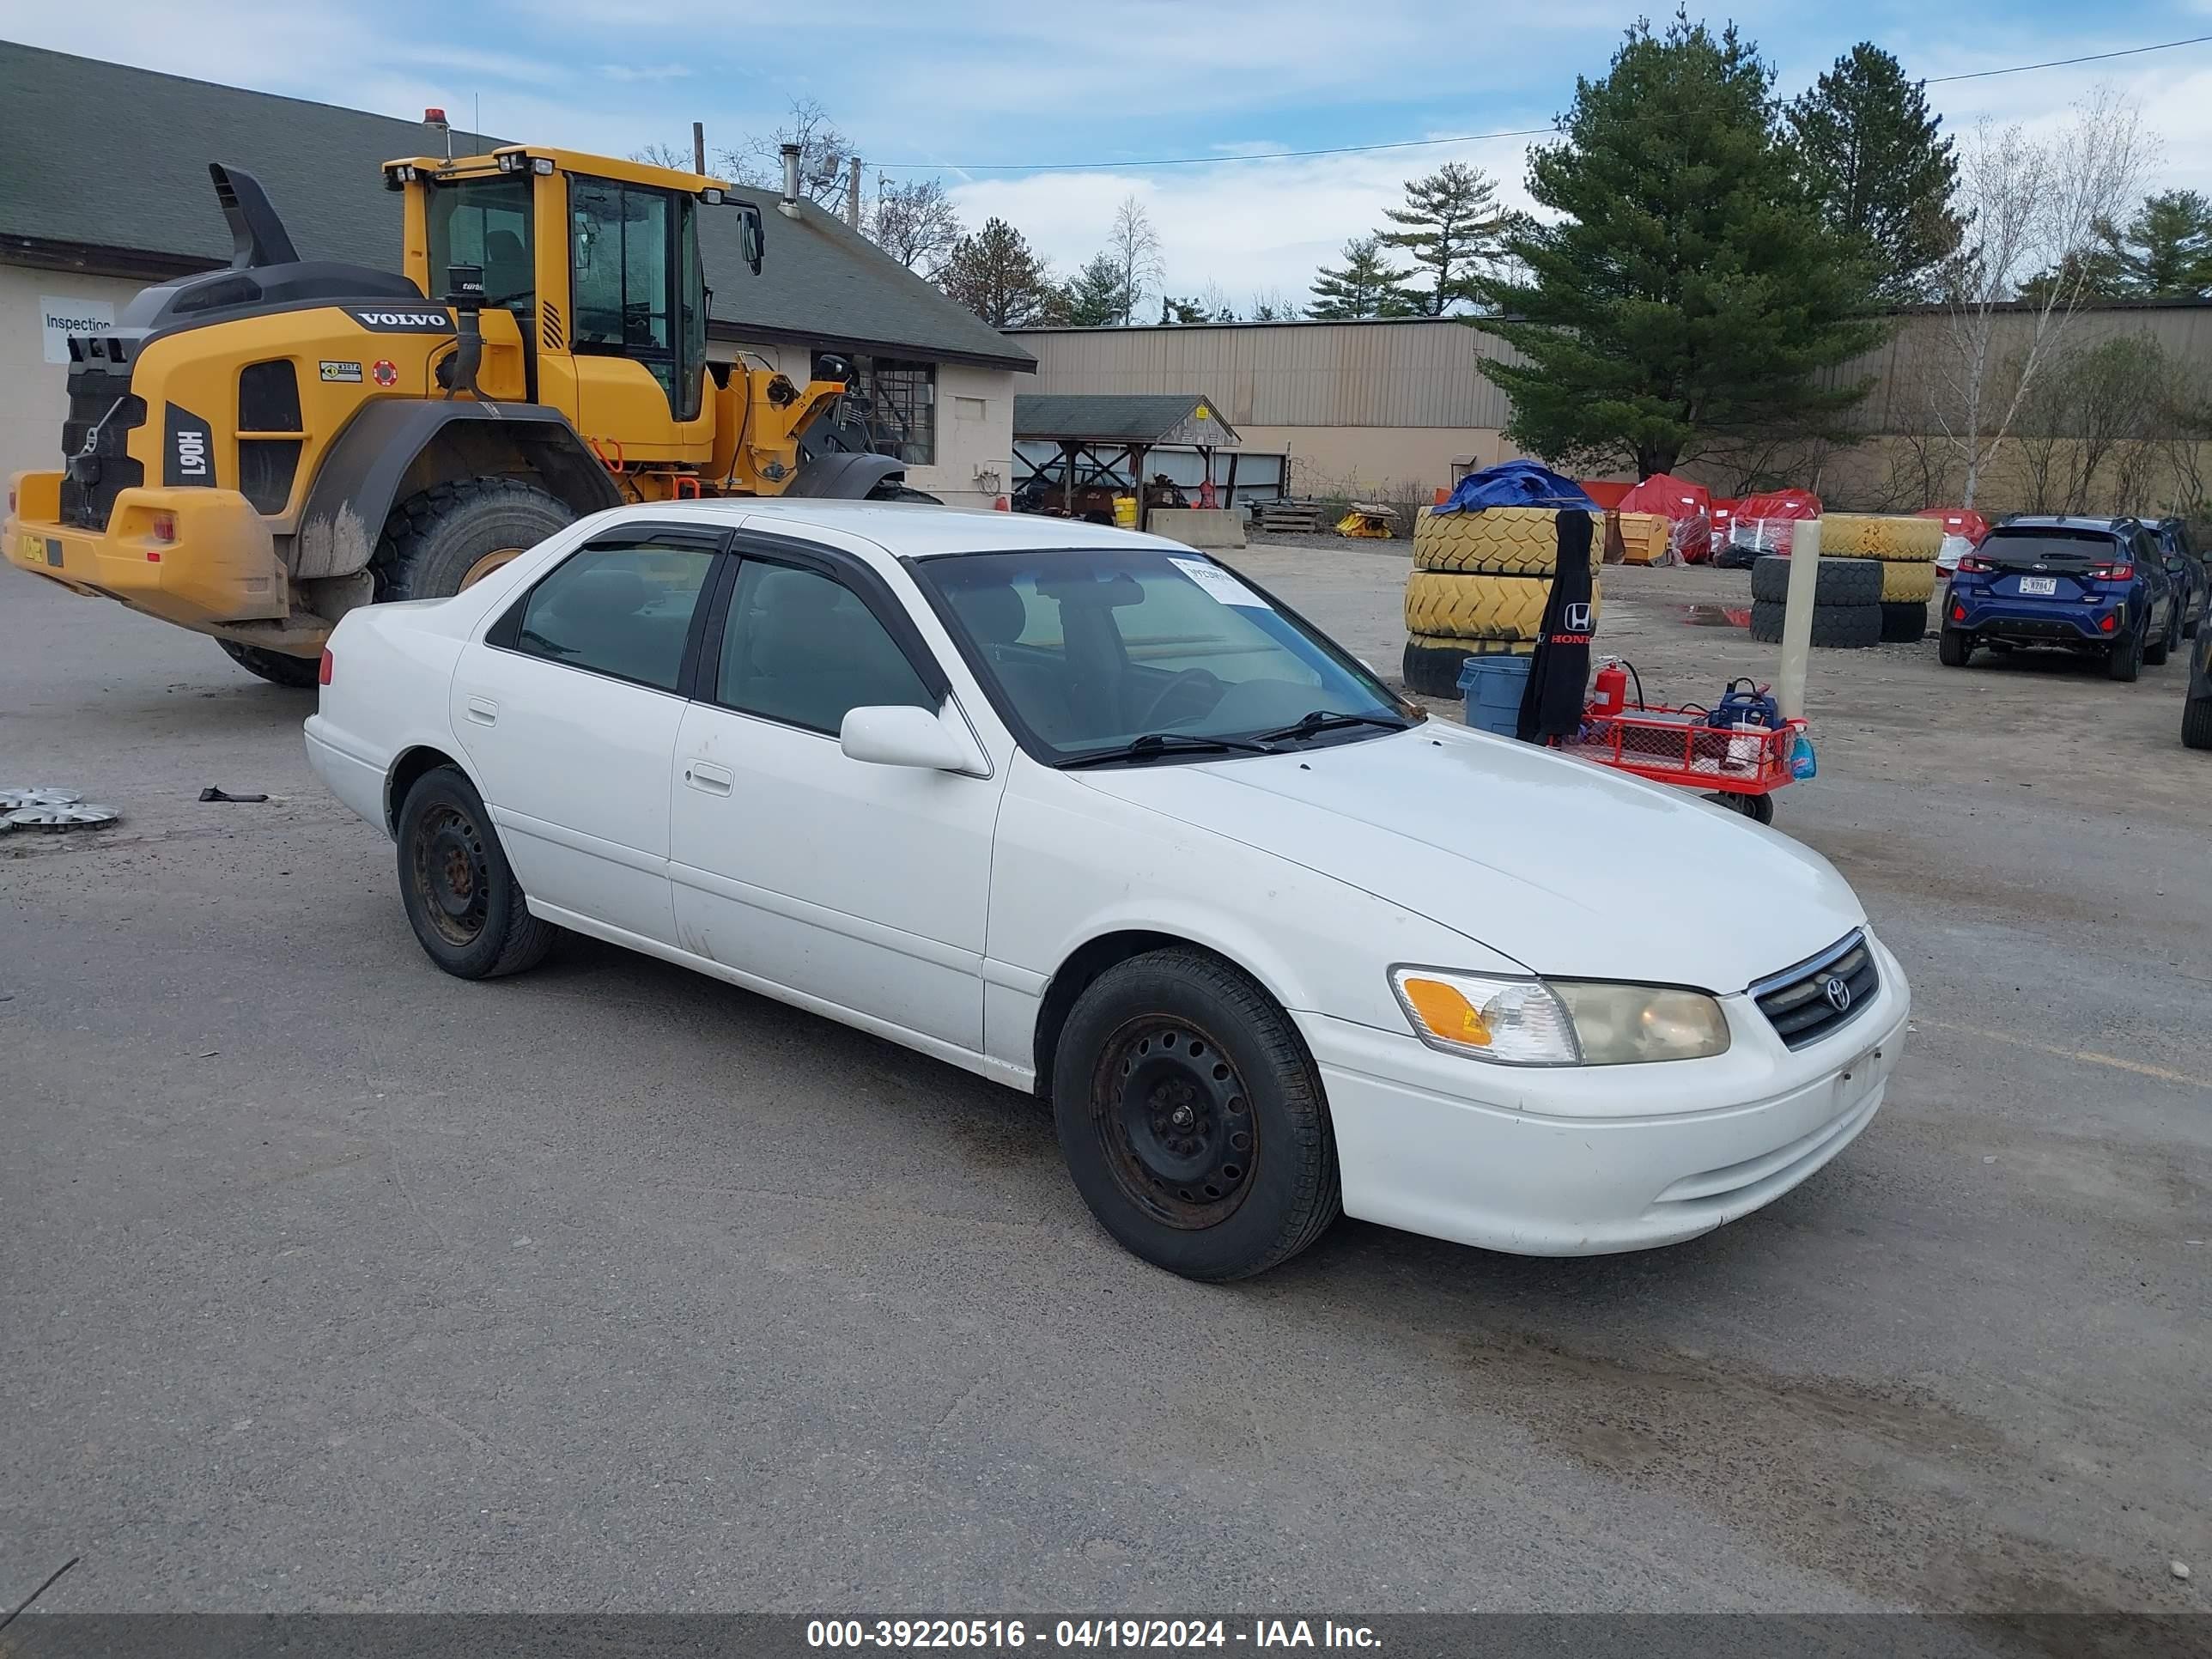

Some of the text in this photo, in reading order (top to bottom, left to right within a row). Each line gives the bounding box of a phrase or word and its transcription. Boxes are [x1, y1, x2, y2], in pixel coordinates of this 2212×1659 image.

[46, 313, 111, 332] Inspection
[357, 313, 447, 326] VOLVO
[177, 431, 207, 475] L90H
